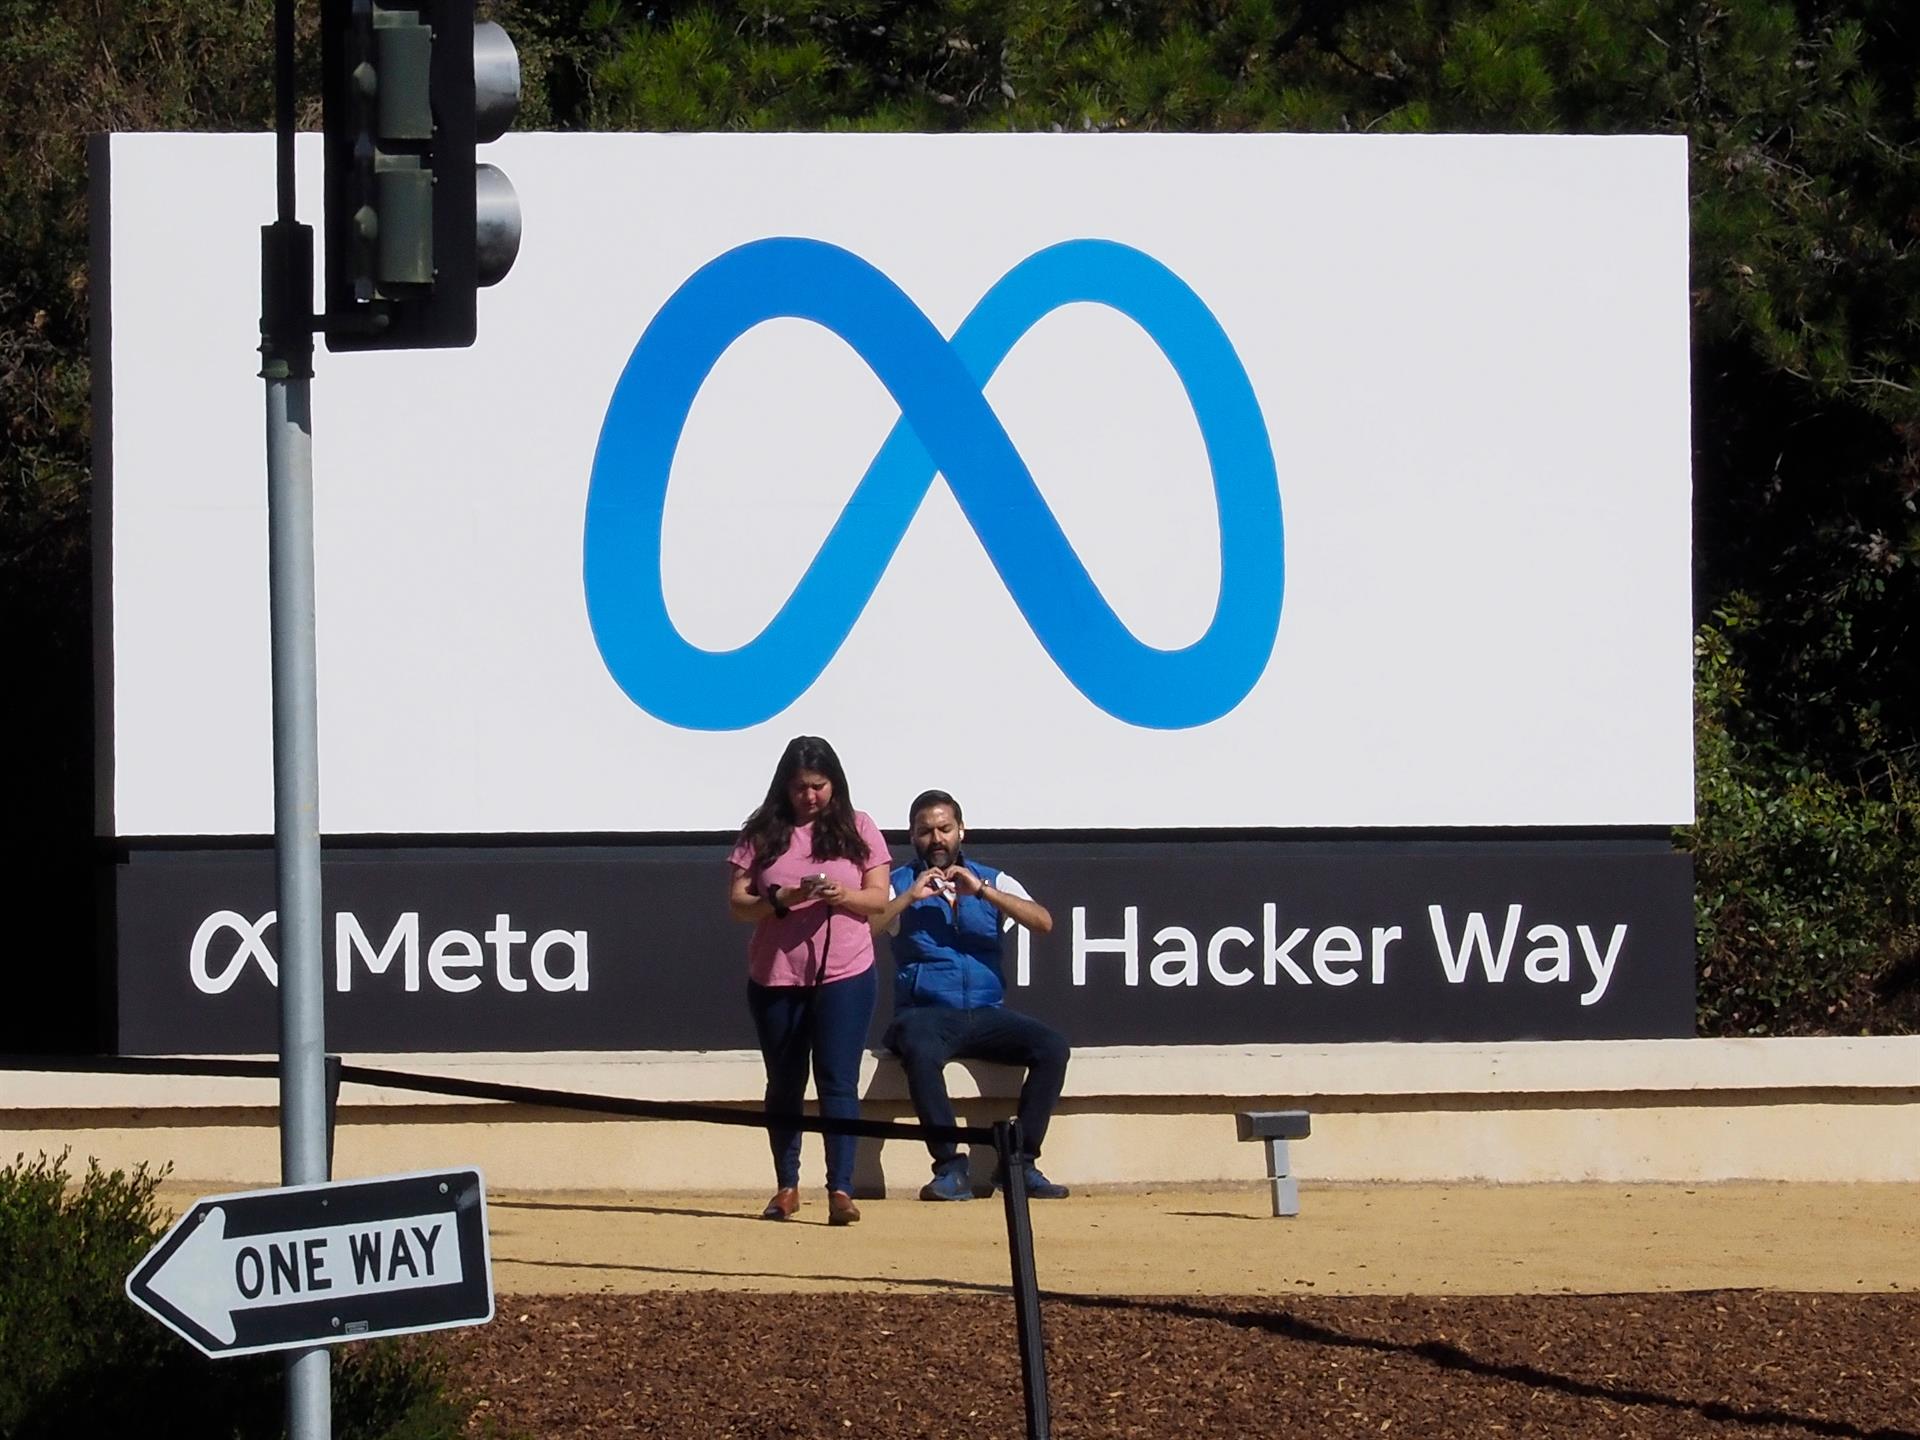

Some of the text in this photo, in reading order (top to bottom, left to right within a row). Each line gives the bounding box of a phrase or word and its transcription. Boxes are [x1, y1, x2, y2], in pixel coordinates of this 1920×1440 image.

[335, 911, 590, 993] Meta
[1071, 902, 1403, 987] Hacker
[1427, 903, 1628, 1007] Way
[235, 1224, 443, 1300] ONE WAY
